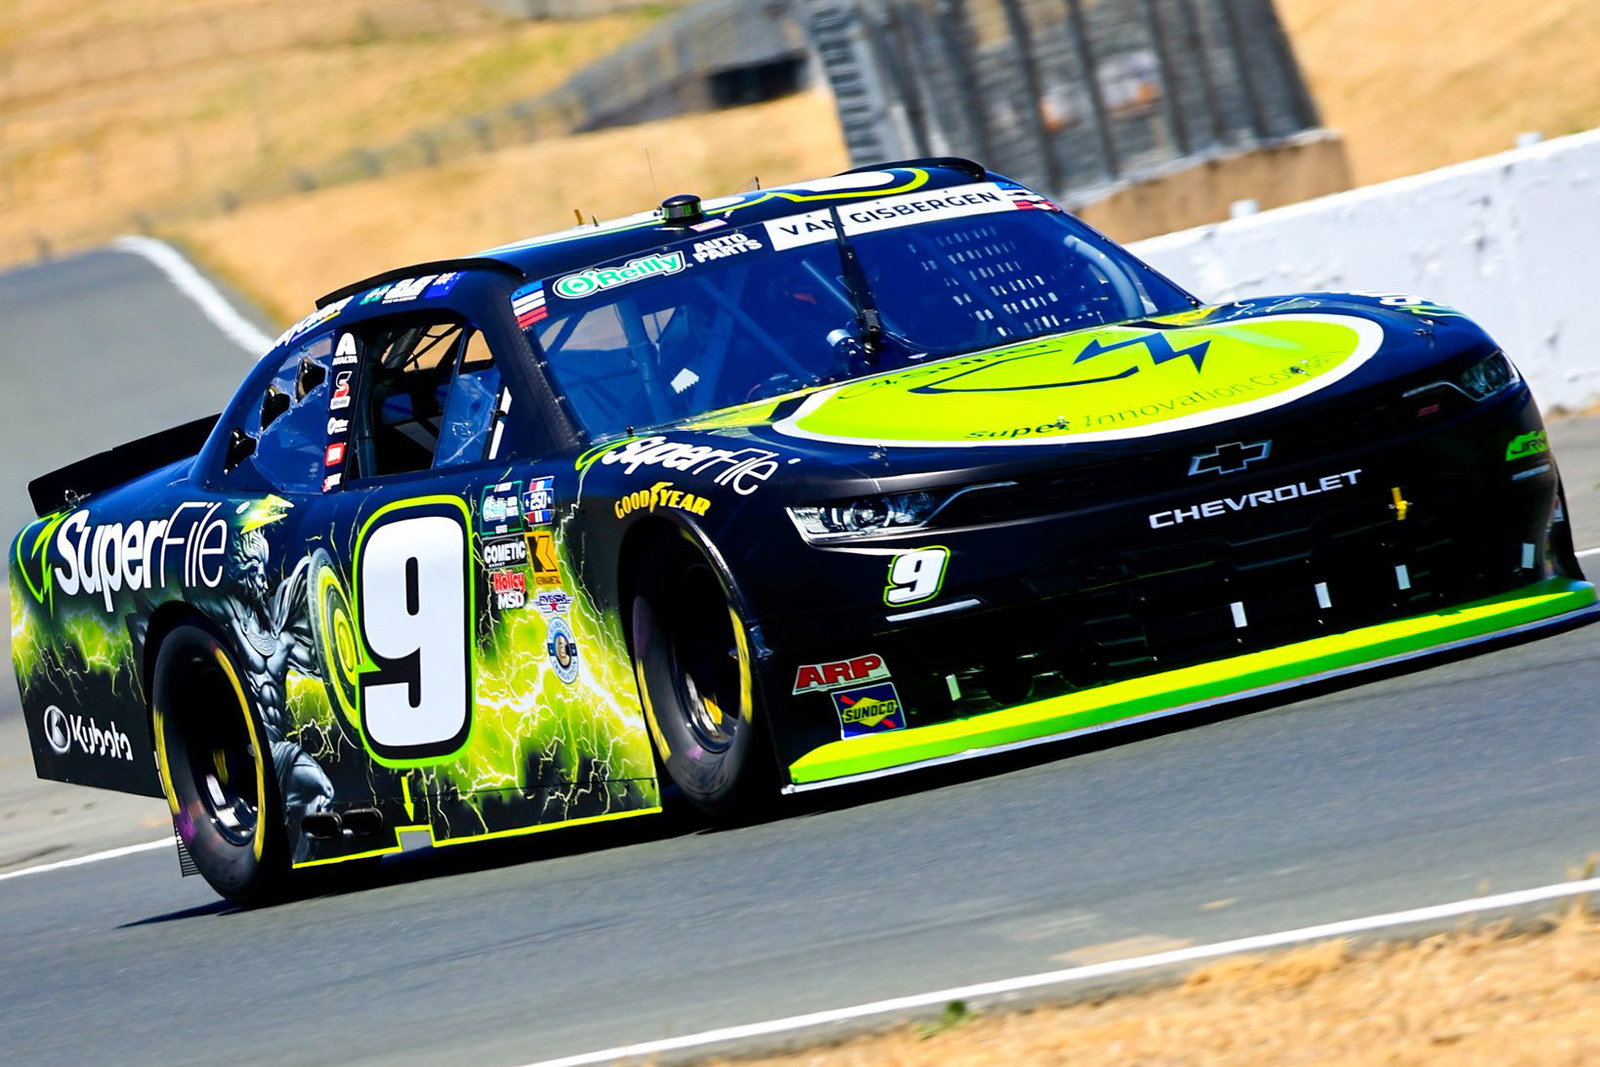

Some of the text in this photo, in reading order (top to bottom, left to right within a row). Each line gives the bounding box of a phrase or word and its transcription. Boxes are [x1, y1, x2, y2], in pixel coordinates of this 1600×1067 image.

[850, 191, 1001, 224] GISBERGEN
[692, 239, 763, 263] PARTS
[693, 233, 748, 253] AUTO
[560, 255, 679, 295] O'Reilly
[601, 436, 780, 496] SuperFile
[613, 481, 712, 519] GOODYEAR
[1148, 468, 1363, 529] CHEVROLET
[54, 501, 228, 613] SuperFile
[483, 540, 526, 564] COMETIC
[493, 569, 526, 593] Holley
[886, 548, 947, 604] 9
[498, 591, 525, 610] MSD
[362, 515, 467, 748] 9
[796, 654, 883, 690] ARP
[845, 700, 897, 721] SUNOCO
[69, 713, 134, 761] Kubota
